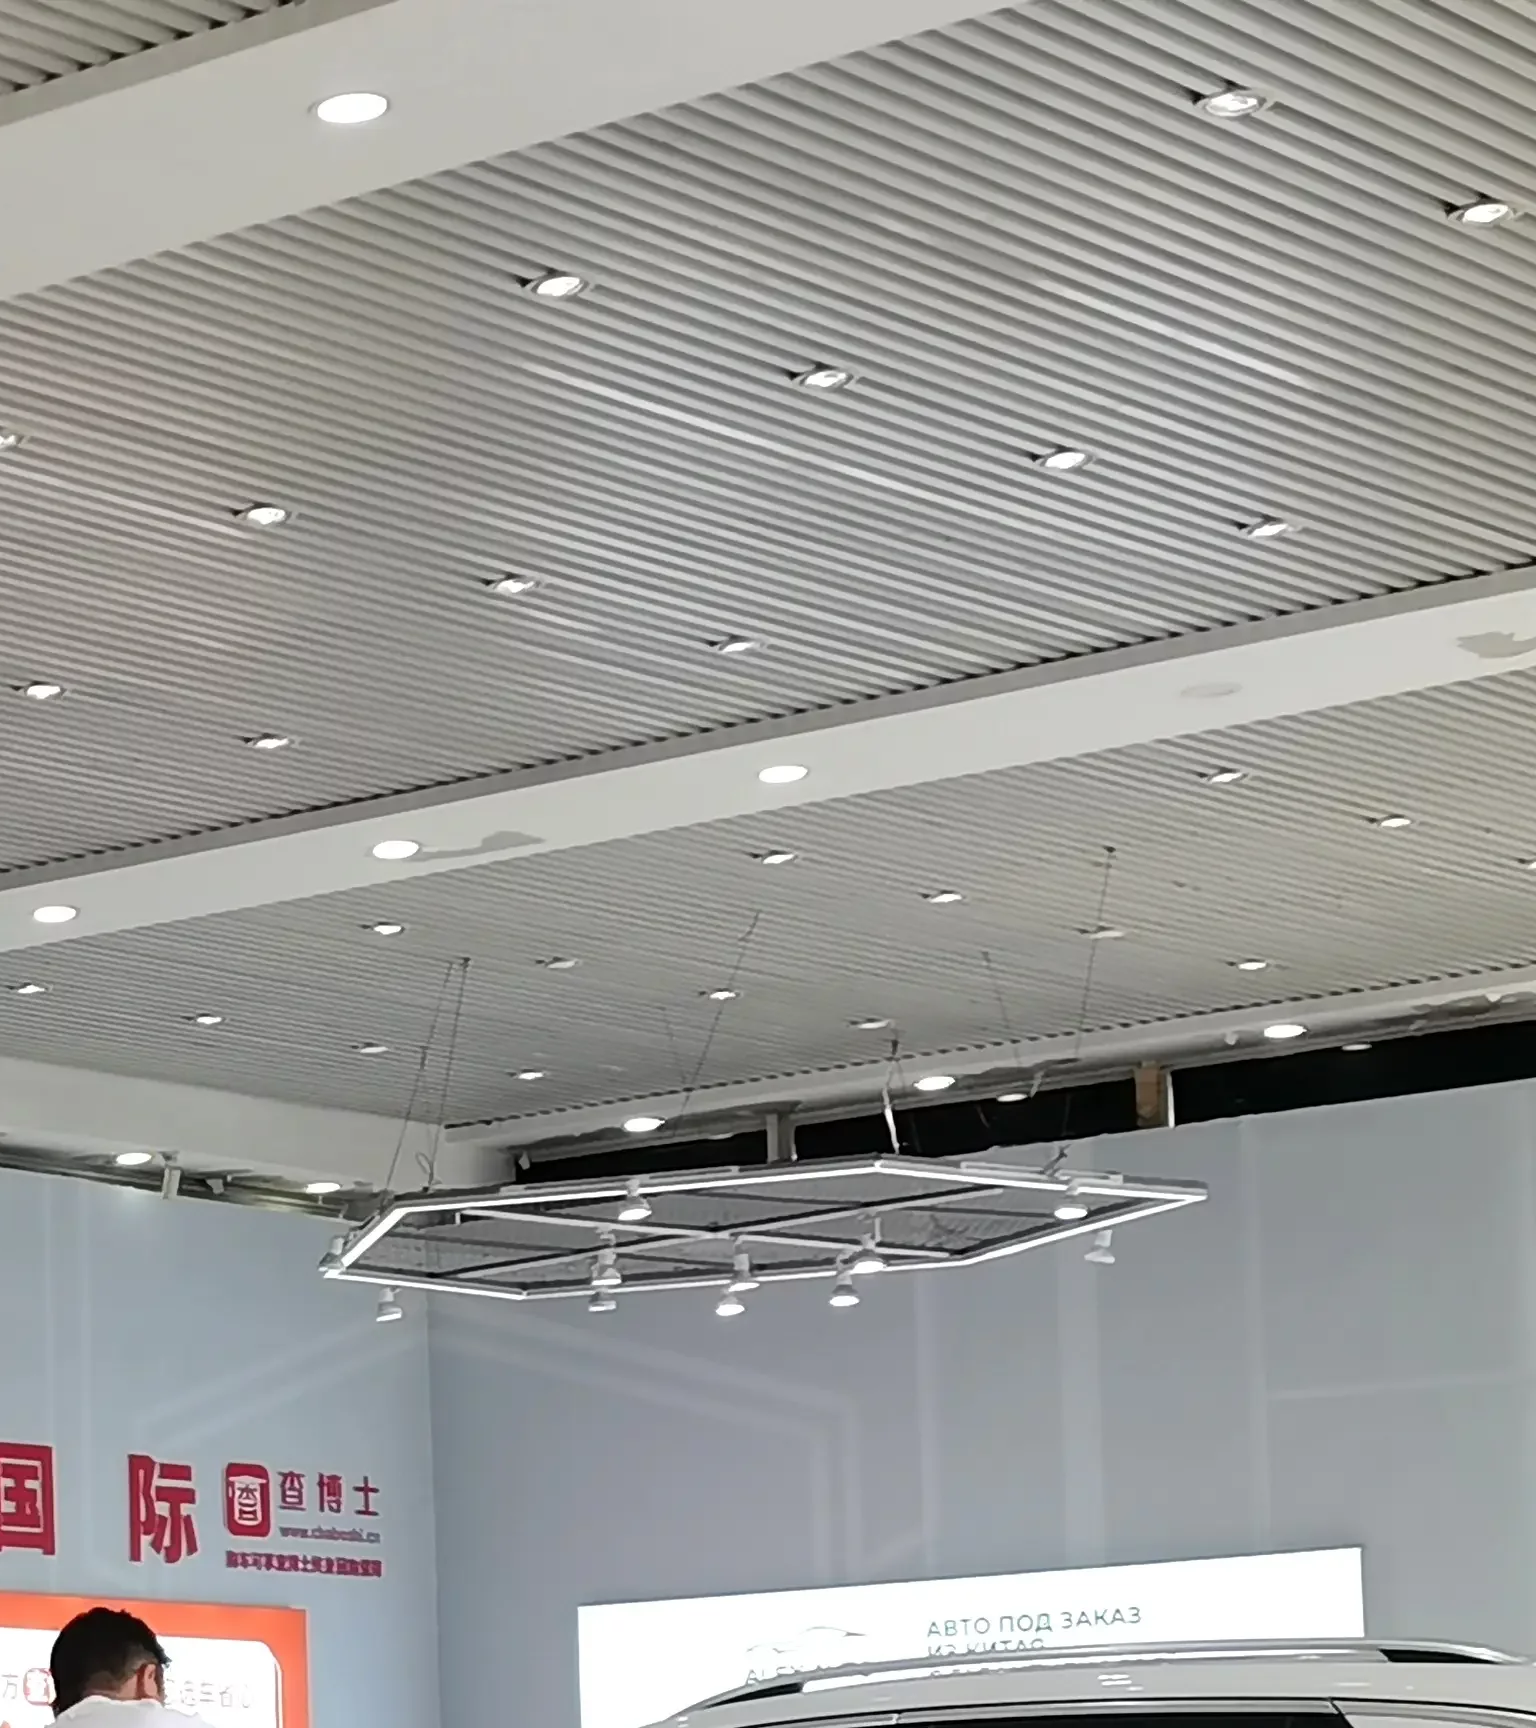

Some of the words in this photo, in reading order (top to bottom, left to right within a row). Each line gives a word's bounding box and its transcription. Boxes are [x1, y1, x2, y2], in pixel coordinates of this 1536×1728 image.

[277, 1470, 381, 1516] 查博士
[927, 1618, 991, 1637] АВТО
[999, 1613, 1053, 1633] ПОД
[1060, 1606, 1142, 1629] ЗАКАЗ
